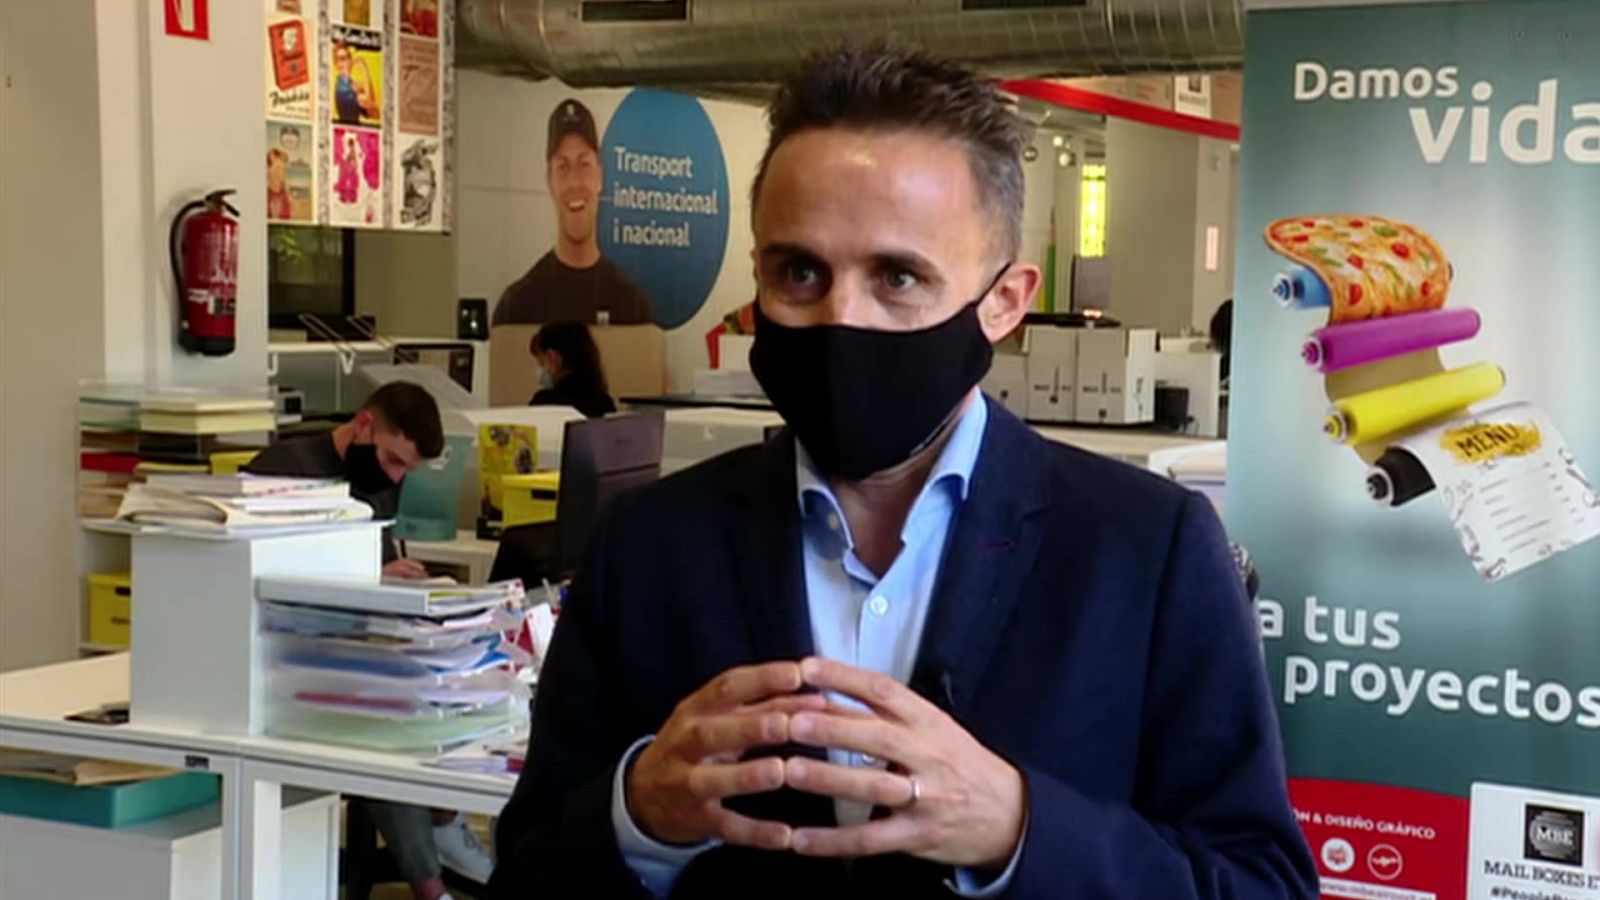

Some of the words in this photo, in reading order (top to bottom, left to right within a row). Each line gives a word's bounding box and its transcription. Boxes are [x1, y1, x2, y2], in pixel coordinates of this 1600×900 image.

[1294, 61, 1459, 100] Damos
[1409, 79, 1600, 164] vida
[614, 146, 694, 179] Transport
[613, 181, 718, 215] internacional
[613, 217, 620, 243] i
[622, 220, 691, 247] nacional
[1455, 423, 1521, 458] MENU
[1257, 599, 1284, 637] a
[1304, 596, 1400, 649] tus
[1284, 655, 1600, 727] proyectos
[1324, 813, 1374, 831] DISEÑO
[1376, 819, 1436, 839] GRÁFICO
[1484, 860, 1529, 880] MAIL
[1532, 866, 1585, 888] BOXES
